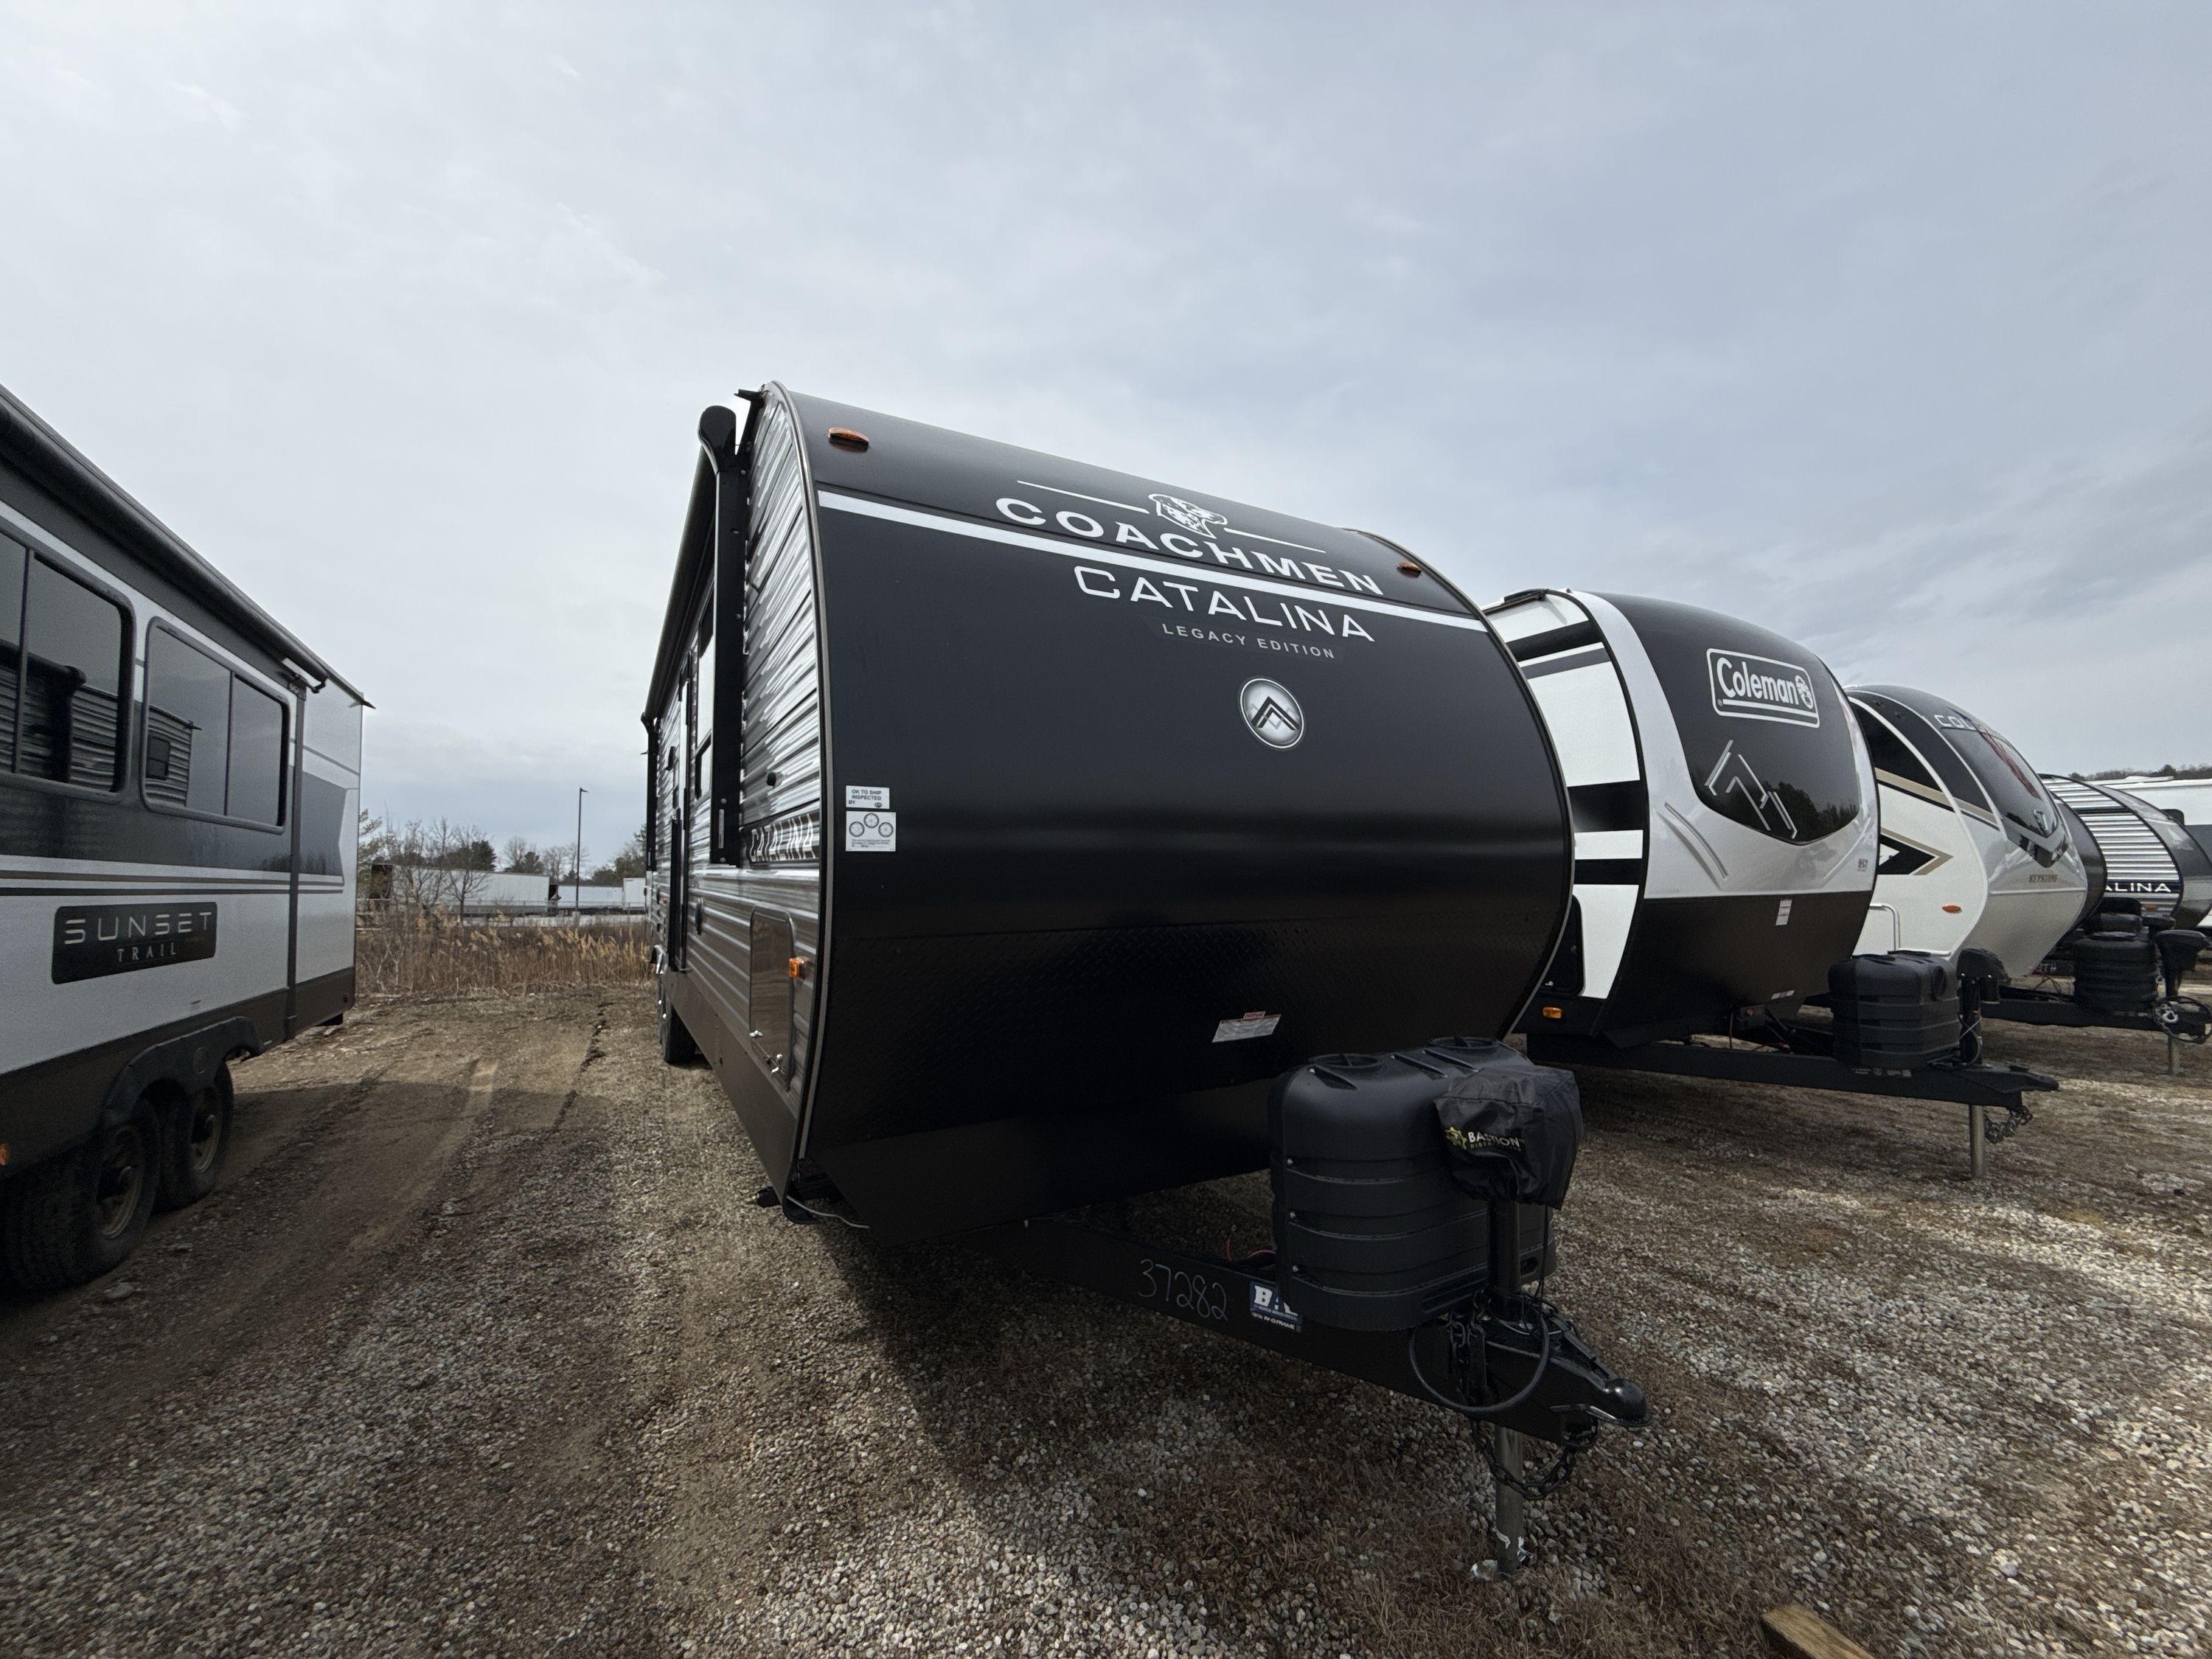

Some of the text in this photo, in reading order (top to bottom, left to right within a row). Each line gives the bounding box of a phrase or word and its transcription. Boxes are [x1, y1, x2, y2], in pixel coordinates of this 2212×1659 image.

[995, 497, 1383, 595] COACHMEN
[1074, 566, 1374, 642] CATALINA
[1162, 623, 1335, 659] LEGACY EDITION
[1717, 657, 1800, 706] Coleman
[749, 813, 816, 862] CATALINA
[64, 911, 212, 945] SUNSET
[116, 942, 176, 962] TRAIL
[1467, 1131, 1520, 1147] BASTION
[1138, 1258, 1229, 1322] 37282
